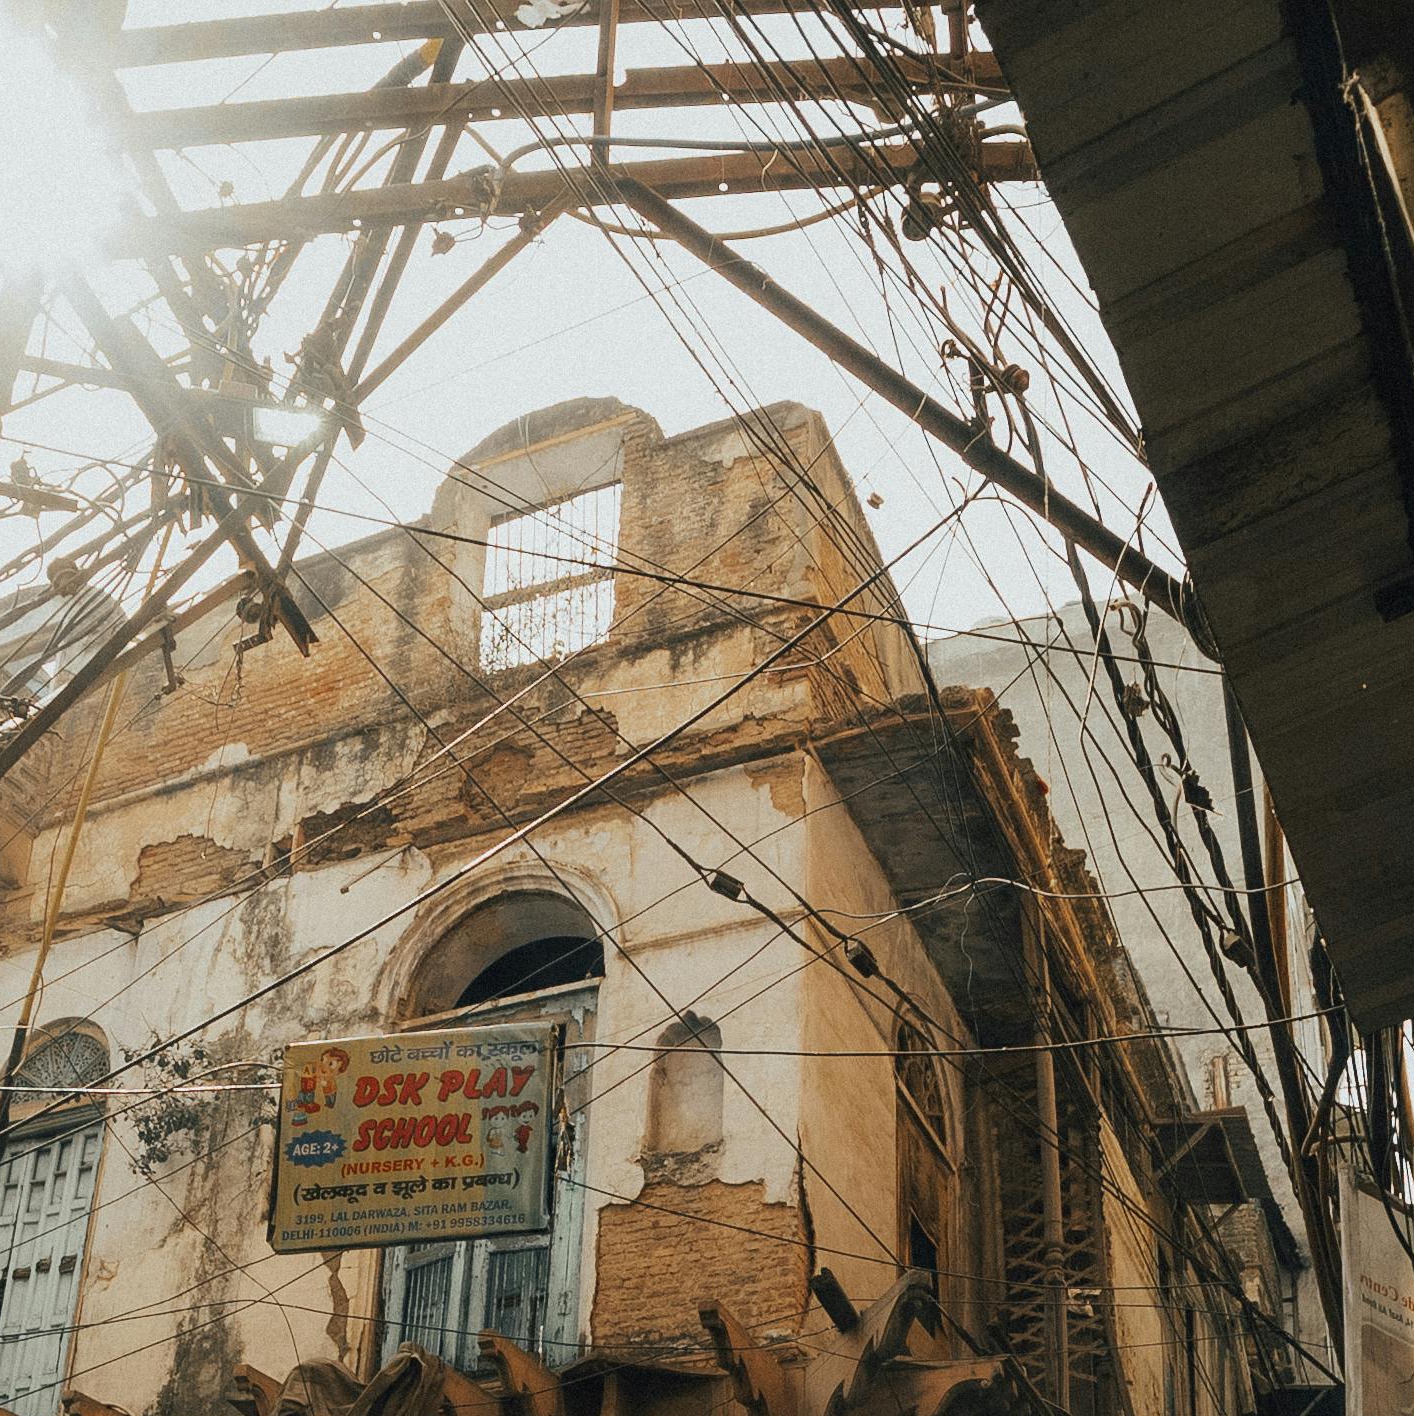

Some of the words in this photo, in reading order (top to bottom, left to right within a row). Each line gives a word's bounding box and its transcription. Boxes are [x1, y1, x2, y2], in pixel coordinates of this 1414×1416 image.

[370, 1046, 403, 1064] छोटे
[407, 1041, 454, 1061] बच्चों
[353, 1071, 430, 1108] DSK
[438, 1064, 536, 1102] PLAY
[352, 1112, 473, 1152] SCHOOL
[292, 1143, 320, 1156] AGE:
[322, 1142, 339, 1154] 2+
[341, 1158, 425, 1178] (NURSERY
[431, 1160, 439, 1168] +
[444, 1153, 485, 1169] K.G.)
[373, 1183, 387, 1195] व
[431, 1175, 457, 1191] का
[330, 1211, 349, 1223] LAL
[413, 1205, 439, 1217] SITA
[441, 1202, 468, 1214] RAM
[363, 1223, 405, 1237] (INDIA)
[425, 1219, 447, 1231] +91
